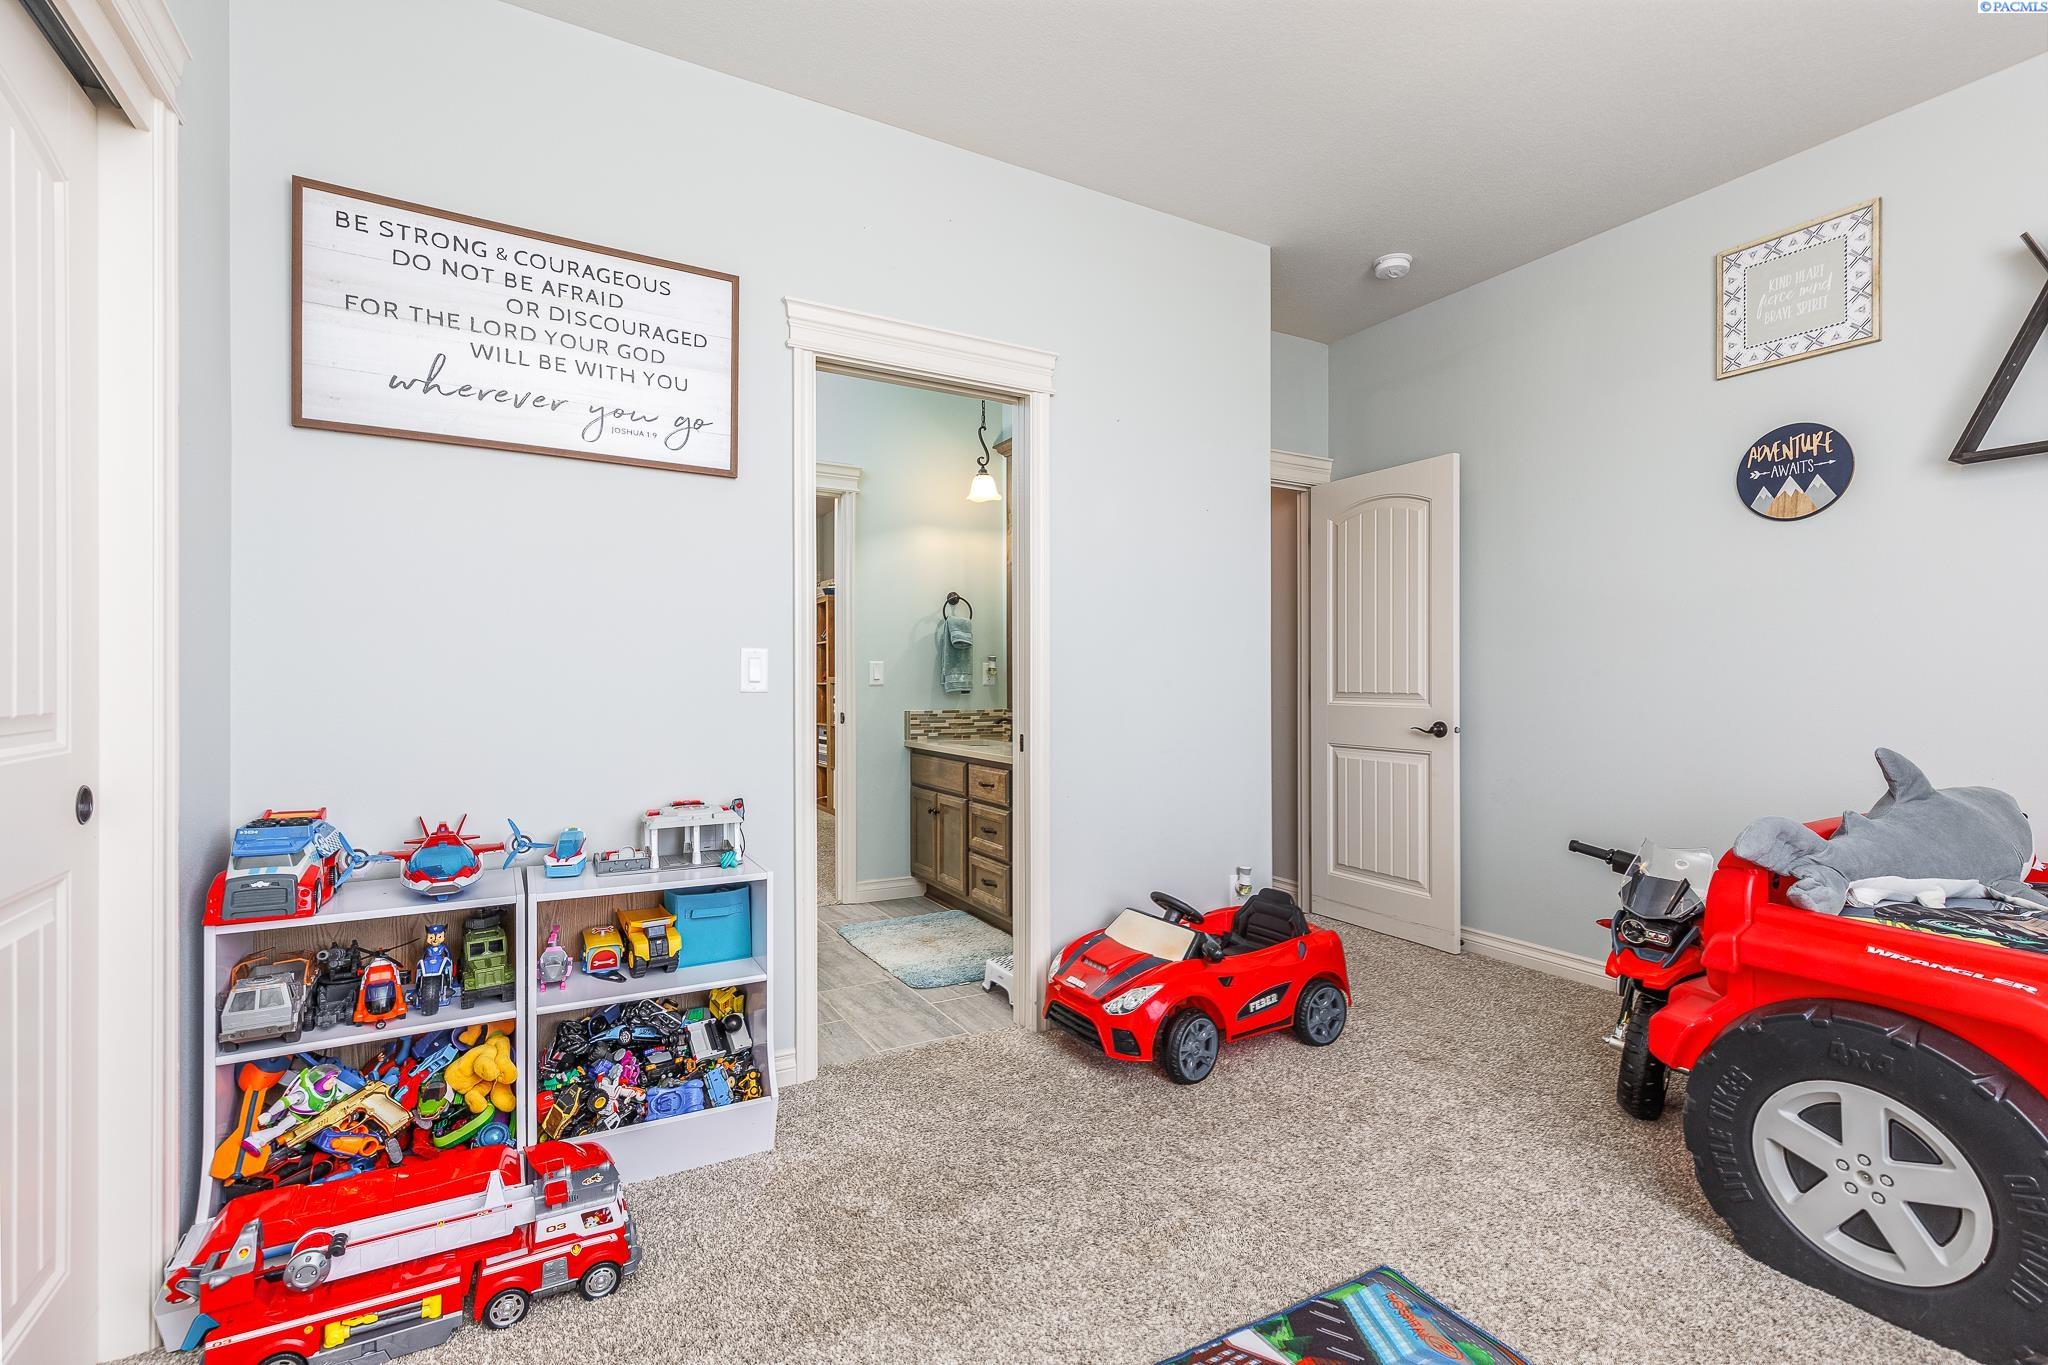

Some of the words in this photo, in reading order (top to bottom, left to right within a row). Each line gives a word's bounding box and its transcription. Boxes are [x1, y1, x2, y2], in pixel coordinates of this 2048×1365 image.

[336, 211, 369, 234] BE
[379, 220, 487, 258] STRONG
[496, 247, 508, 261] &
[513, 250, 671, 296] COURAGEOUS
[1768, 273, 1793, 293] KIND
[1795, 263, 1824, 285] HEART
[393, 249, 431, 272] DO
[442, 259, 495, 284] NOT
[505, 272, 533, 292] BE
[541, 280, 624, 309] AFRAID
[1757, 289, 1793, 320] fierce
[1799, 271, 1832, 296] mind
[346, 294, 399, 319] FOR
[409, 306, 461, 330] THE
[471, 316, 537, 342] LORD
[545, 329, 609, 356] YOUR
[617, 343, 666, 364] GOD
[507, 298, 540, 318] OR
[549, 306, 707, 348] DISCOURAGED
[1764, 305, 1792, 324] BRAVE
[1796, 294, 1829, 316] SPIRIT
[470, 342, 531, 367] WILL
[540, 354, 567, 374] BE
[575, 360, 635, 384] WITH
[643, 371, 688, 392] YOU
[389, 353, 569, 412] wherever
[582, 404, 659, 443] you
[664, 415, 714, 451] go
[611, 426, 645, 437] JOSHUA
[1747, 430, 1834, 469] ADVENTURE
[1770, 458, 1815, 479] AWAITS
[1866, 945, 2039, 994] WRANGLER
[545, 1222, 567, 1233] 03
